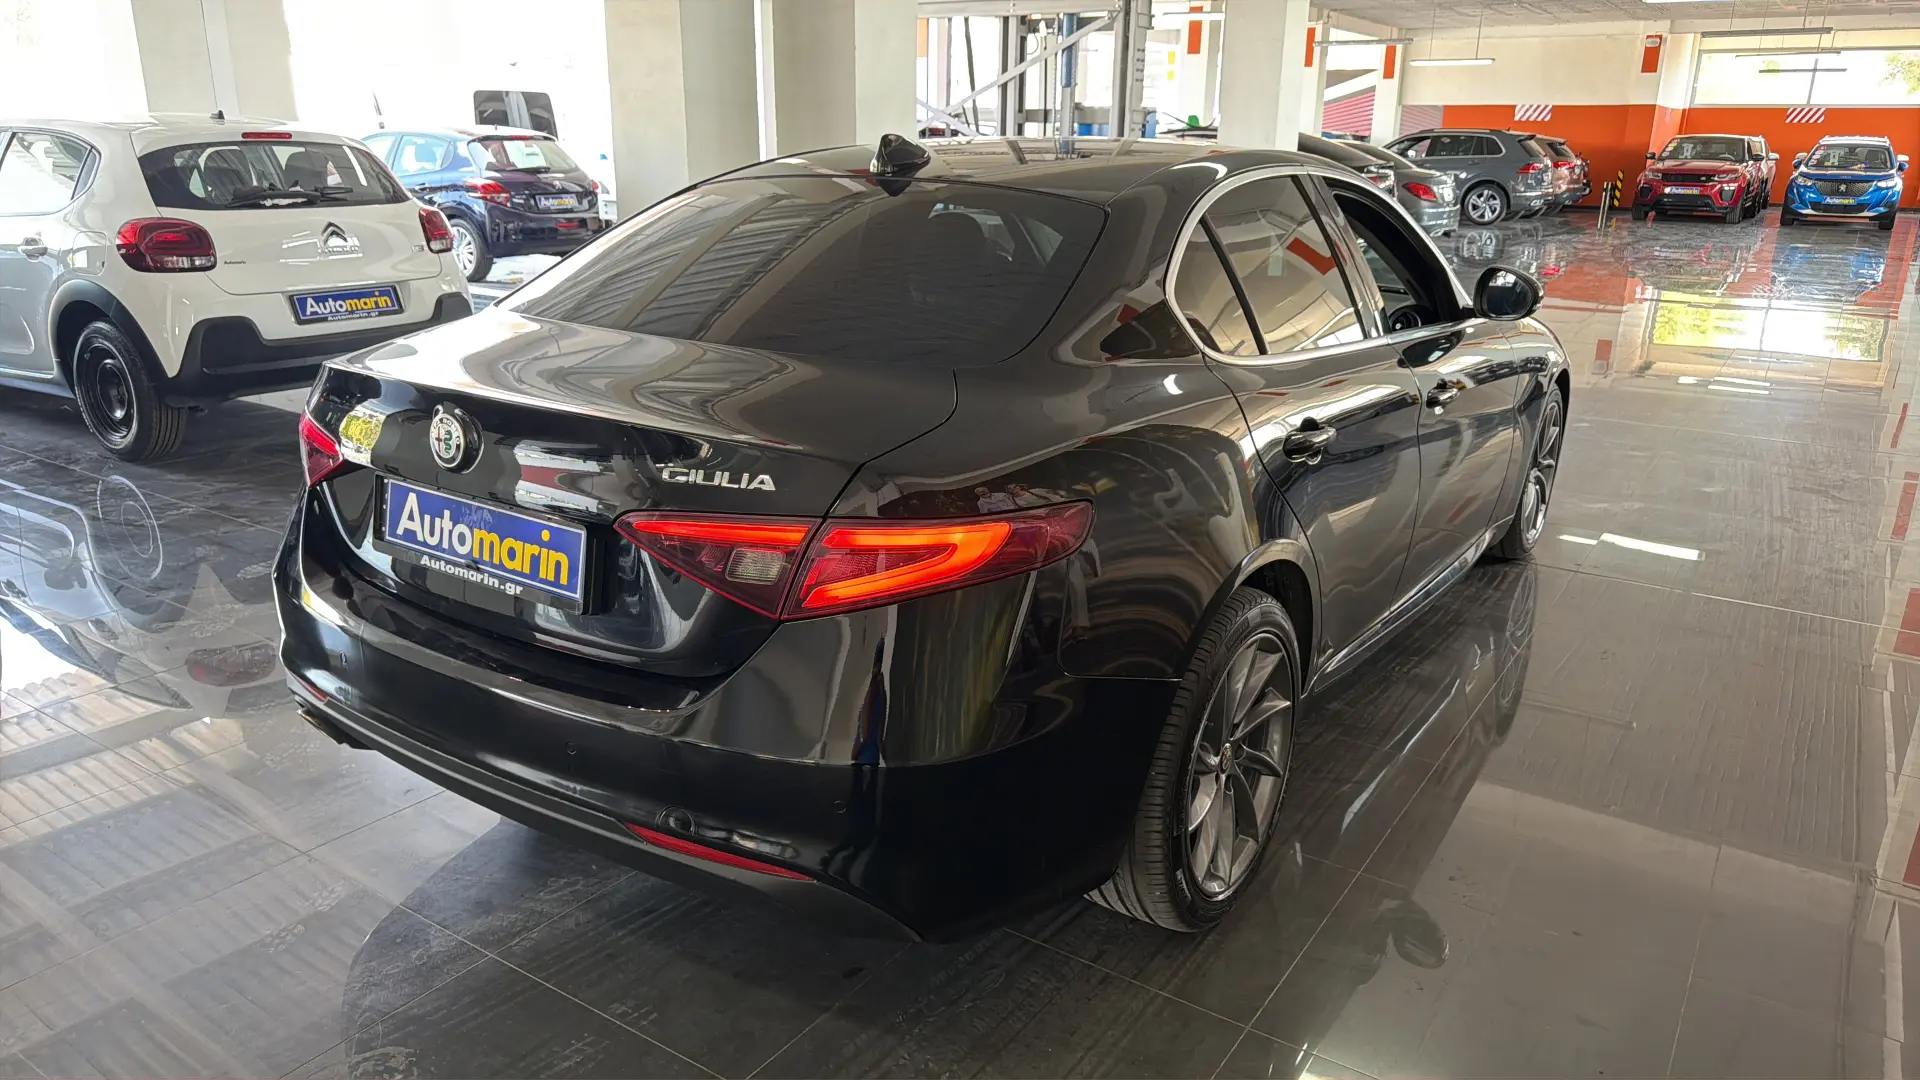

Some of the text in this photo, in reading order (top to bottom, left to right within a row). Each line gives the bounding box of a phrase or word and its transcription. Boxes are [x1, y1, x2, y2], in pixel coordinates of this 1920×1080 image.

[305, 291, 392, 316] Automarin
[327, 311, 379, 321] Automarin.gr
[661, 467, 776, 491] GIULIA
[396, 492, 569, 585] Automarin
[420, 555, 524, 595] Automarin.gr
